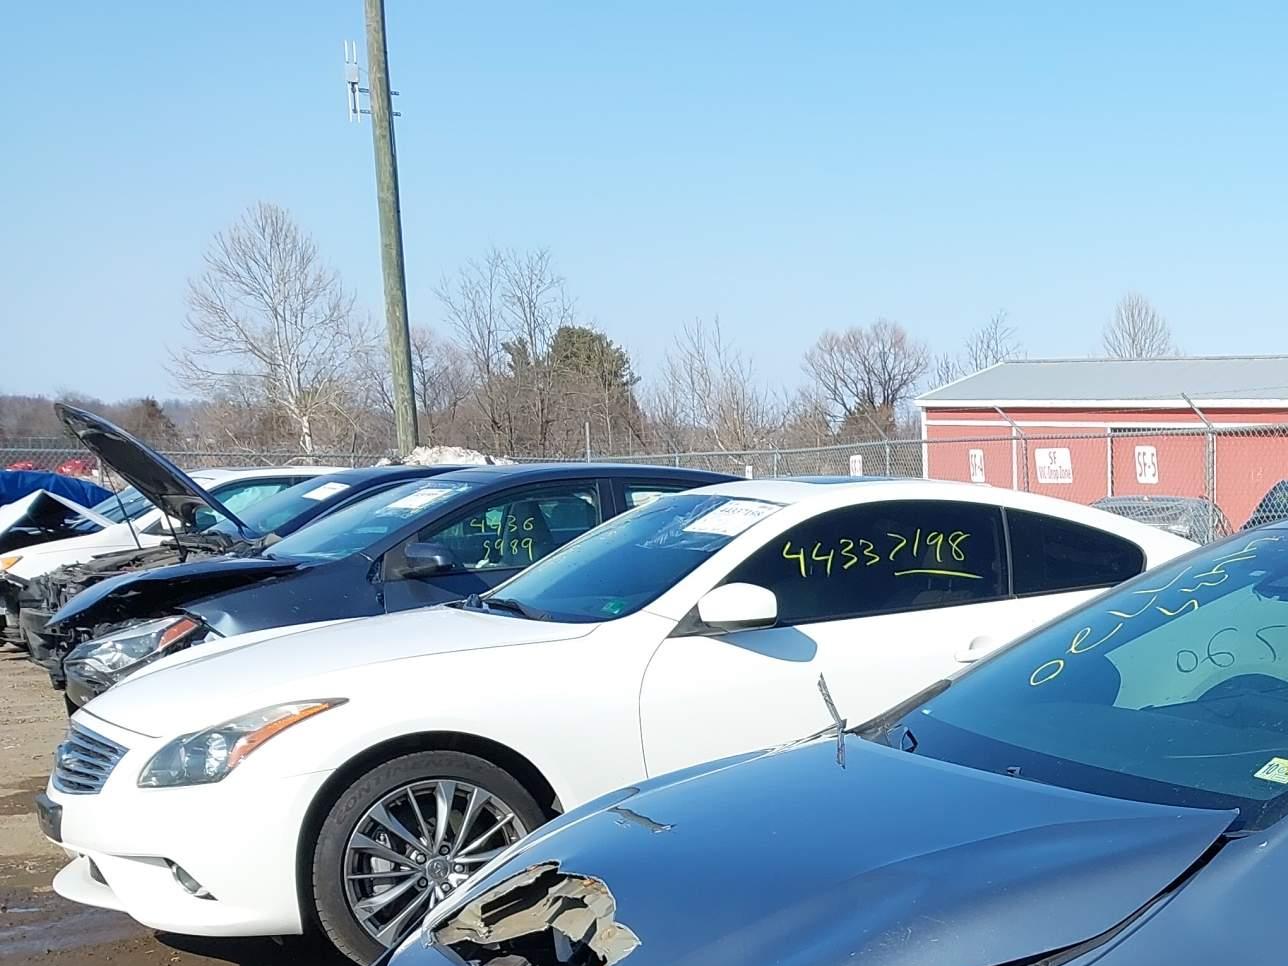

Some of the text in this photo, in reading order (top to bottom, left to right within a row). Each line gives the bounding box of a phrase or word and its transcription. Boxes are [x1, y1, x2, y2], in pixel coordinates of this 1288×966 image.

[1137, 451, 1157, 477] SF-5
[782, 528, 972, 579] 44337198
[1262, 763, 1280, 775] 10
